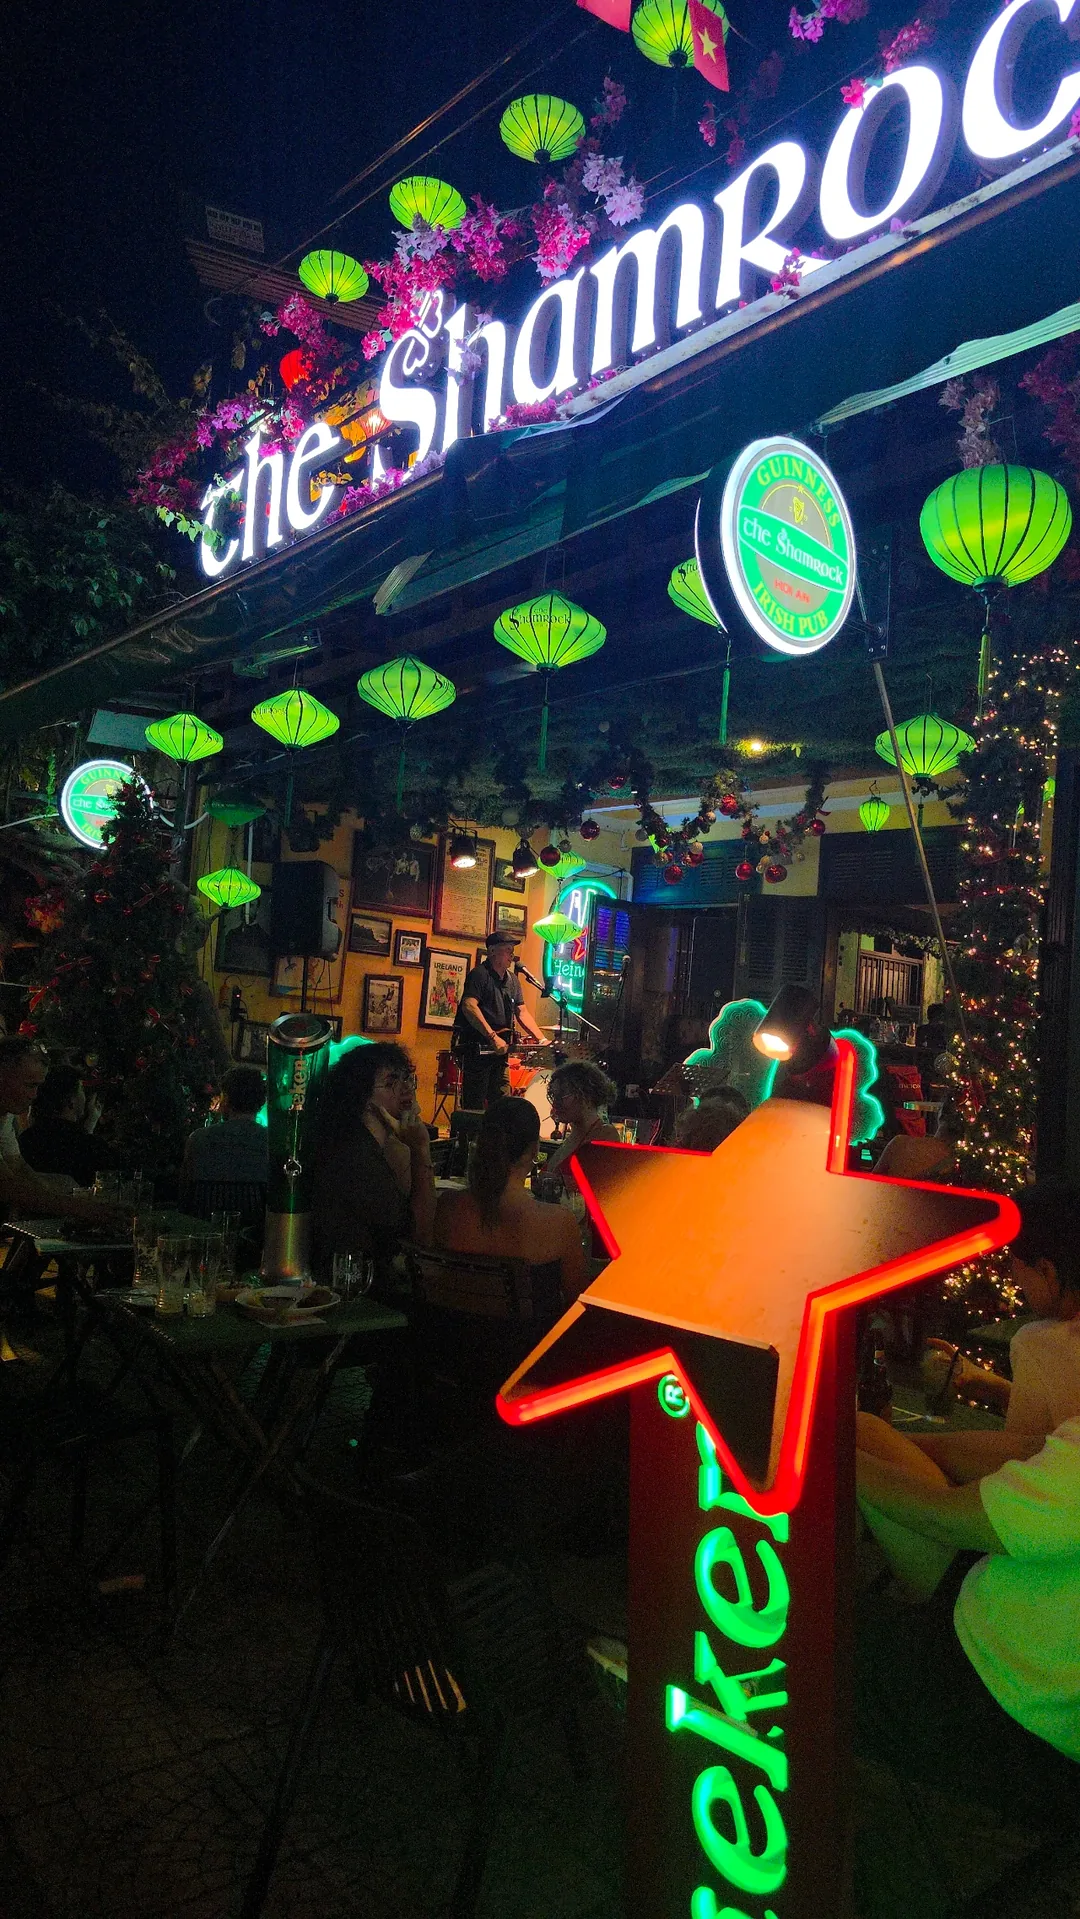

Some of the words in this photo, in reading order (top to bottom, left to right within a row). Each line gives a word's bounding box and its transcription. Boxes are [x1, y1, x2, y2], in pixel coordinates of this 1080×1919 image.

[199, 420, 341, 578] the
[756, 456, 841, 529] GUINNESS
[743, 516, 771, 547] the
[752, 581, 796, 636] IRISH
[799, 609, 829, 637] PUB
[81, 822, 103, 839] IRIS
[433, 962, 463, 973] IRELAND
